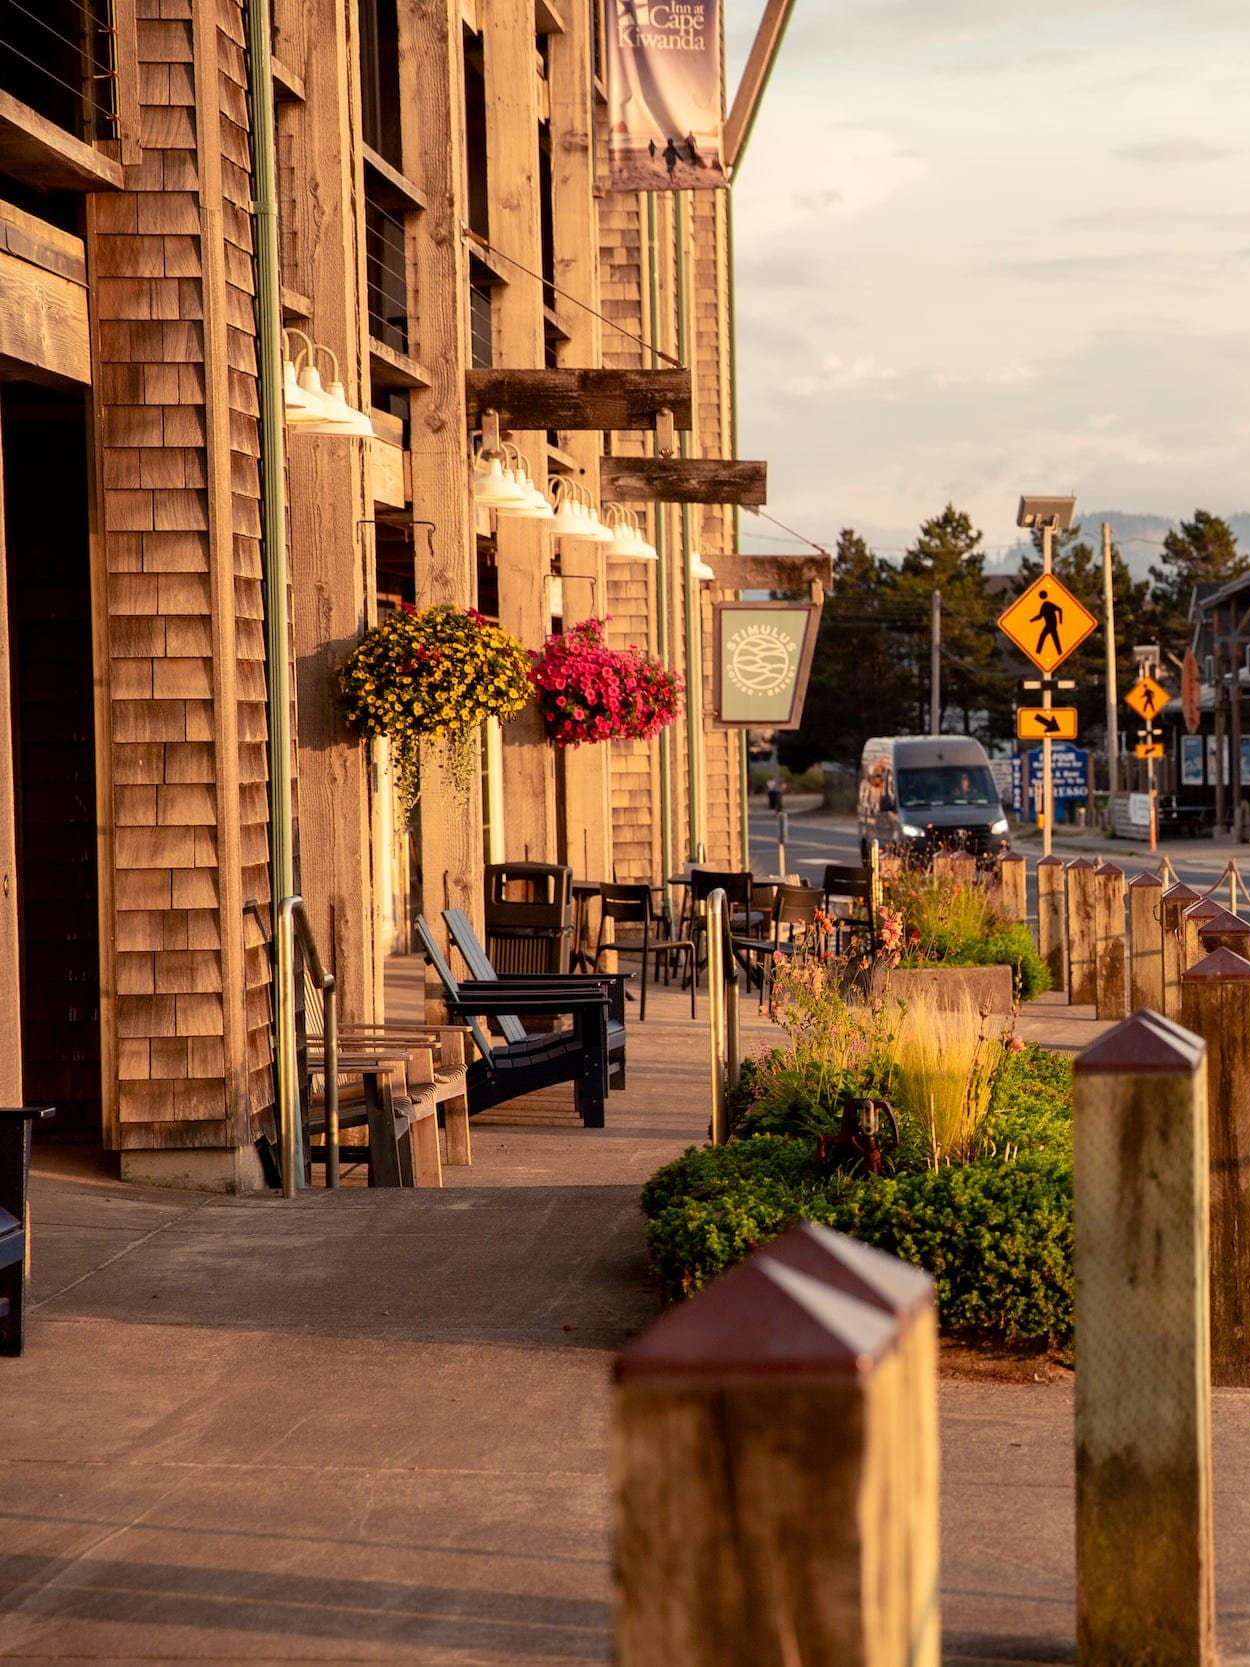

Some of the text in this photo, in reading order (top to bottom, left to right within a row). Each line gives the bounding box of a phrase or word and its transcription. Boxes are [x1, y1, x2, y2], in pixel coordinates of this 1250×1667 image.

[649, 5, 705, 36] Cape
[671, 1, 704, 15] Inn at
[617, 26, 705, 51] Kiwanda
[726, 624, 796, 652] STIMULUS
[726, 664, 795, 697] COFFEE BAKERY
